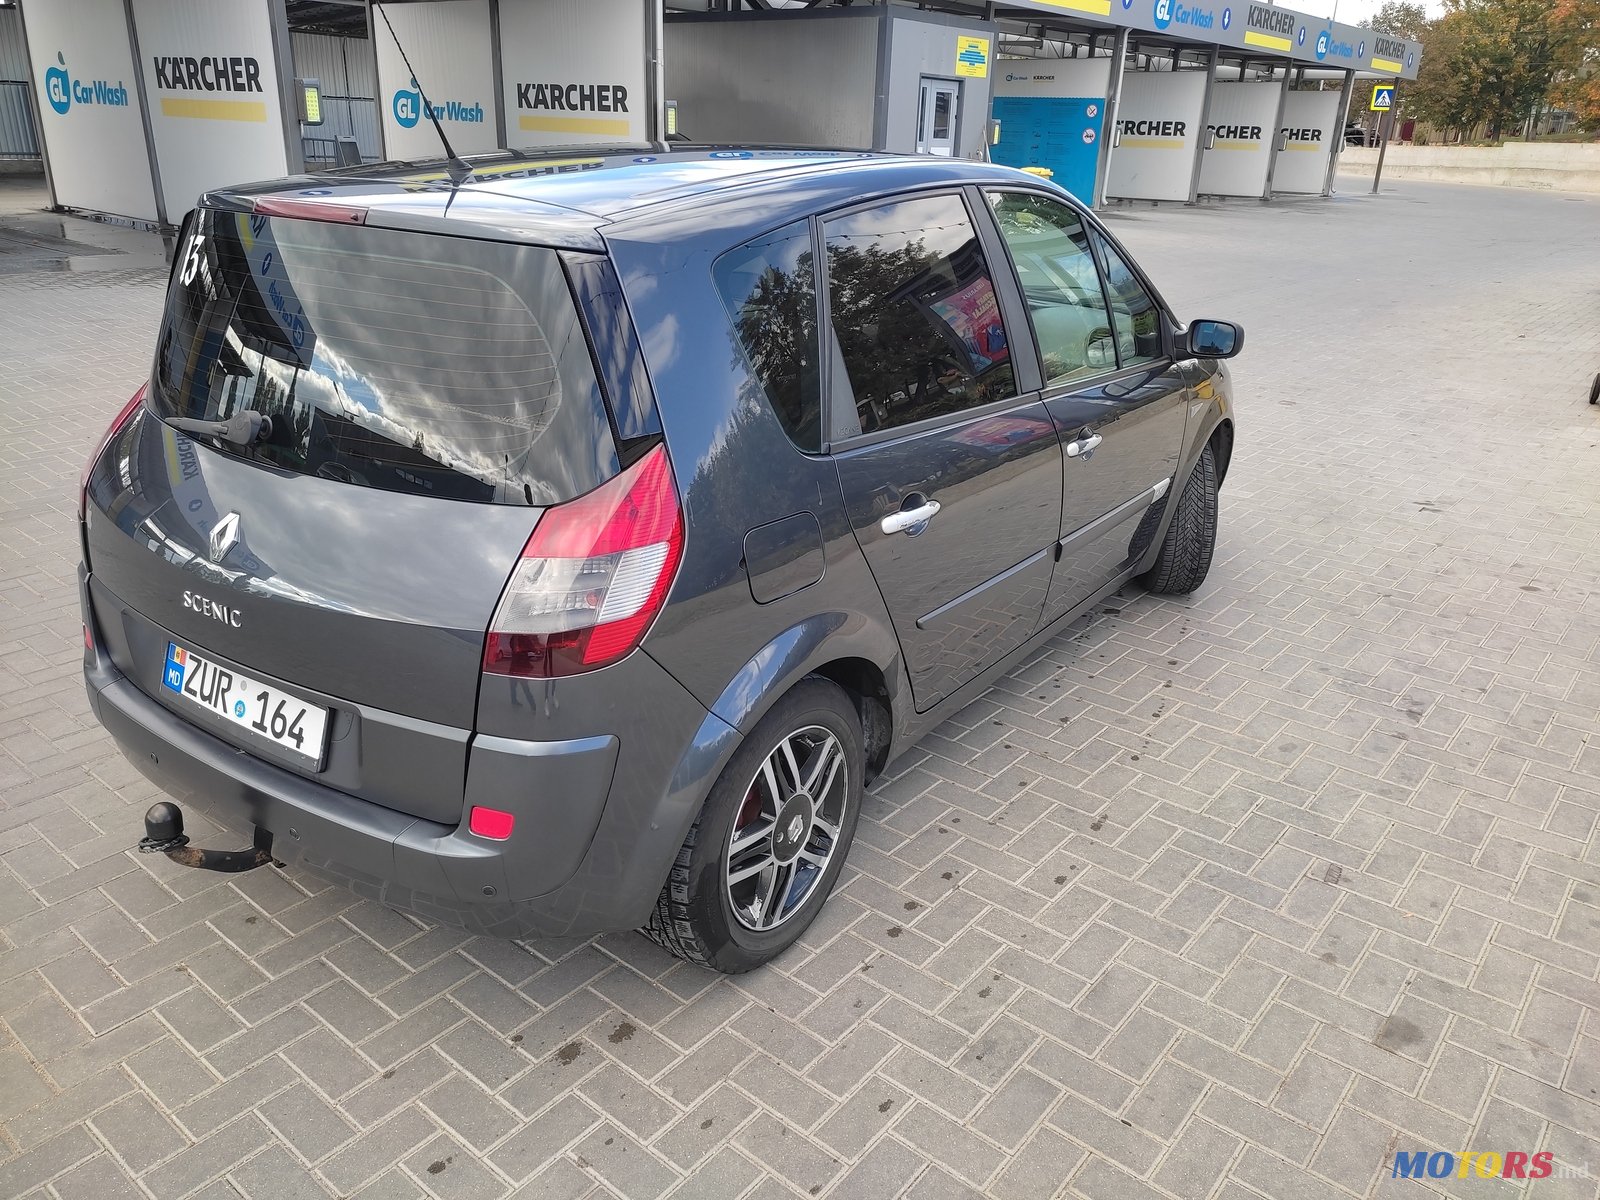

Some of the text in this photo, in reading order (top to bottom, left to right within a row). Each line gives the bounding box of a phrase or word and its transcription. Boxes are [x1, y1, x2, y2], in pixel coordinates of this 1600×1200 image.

[1156, 0, 1170, 21] GL
[1247, 5, 1295, 35] KÄRCHER
[1374, 37, 1406, 59] KÄRCHER
[49, 76, 68, 103] GL
[153, 56, 264, 93] KÄRCHER
[397, 98, 416, 119] GL
[517, 83, 629, 113] KÄRCHER
[183, 590, 243, 628] SCENIC
[167, 654, 307, 749] MD ZUR 164
